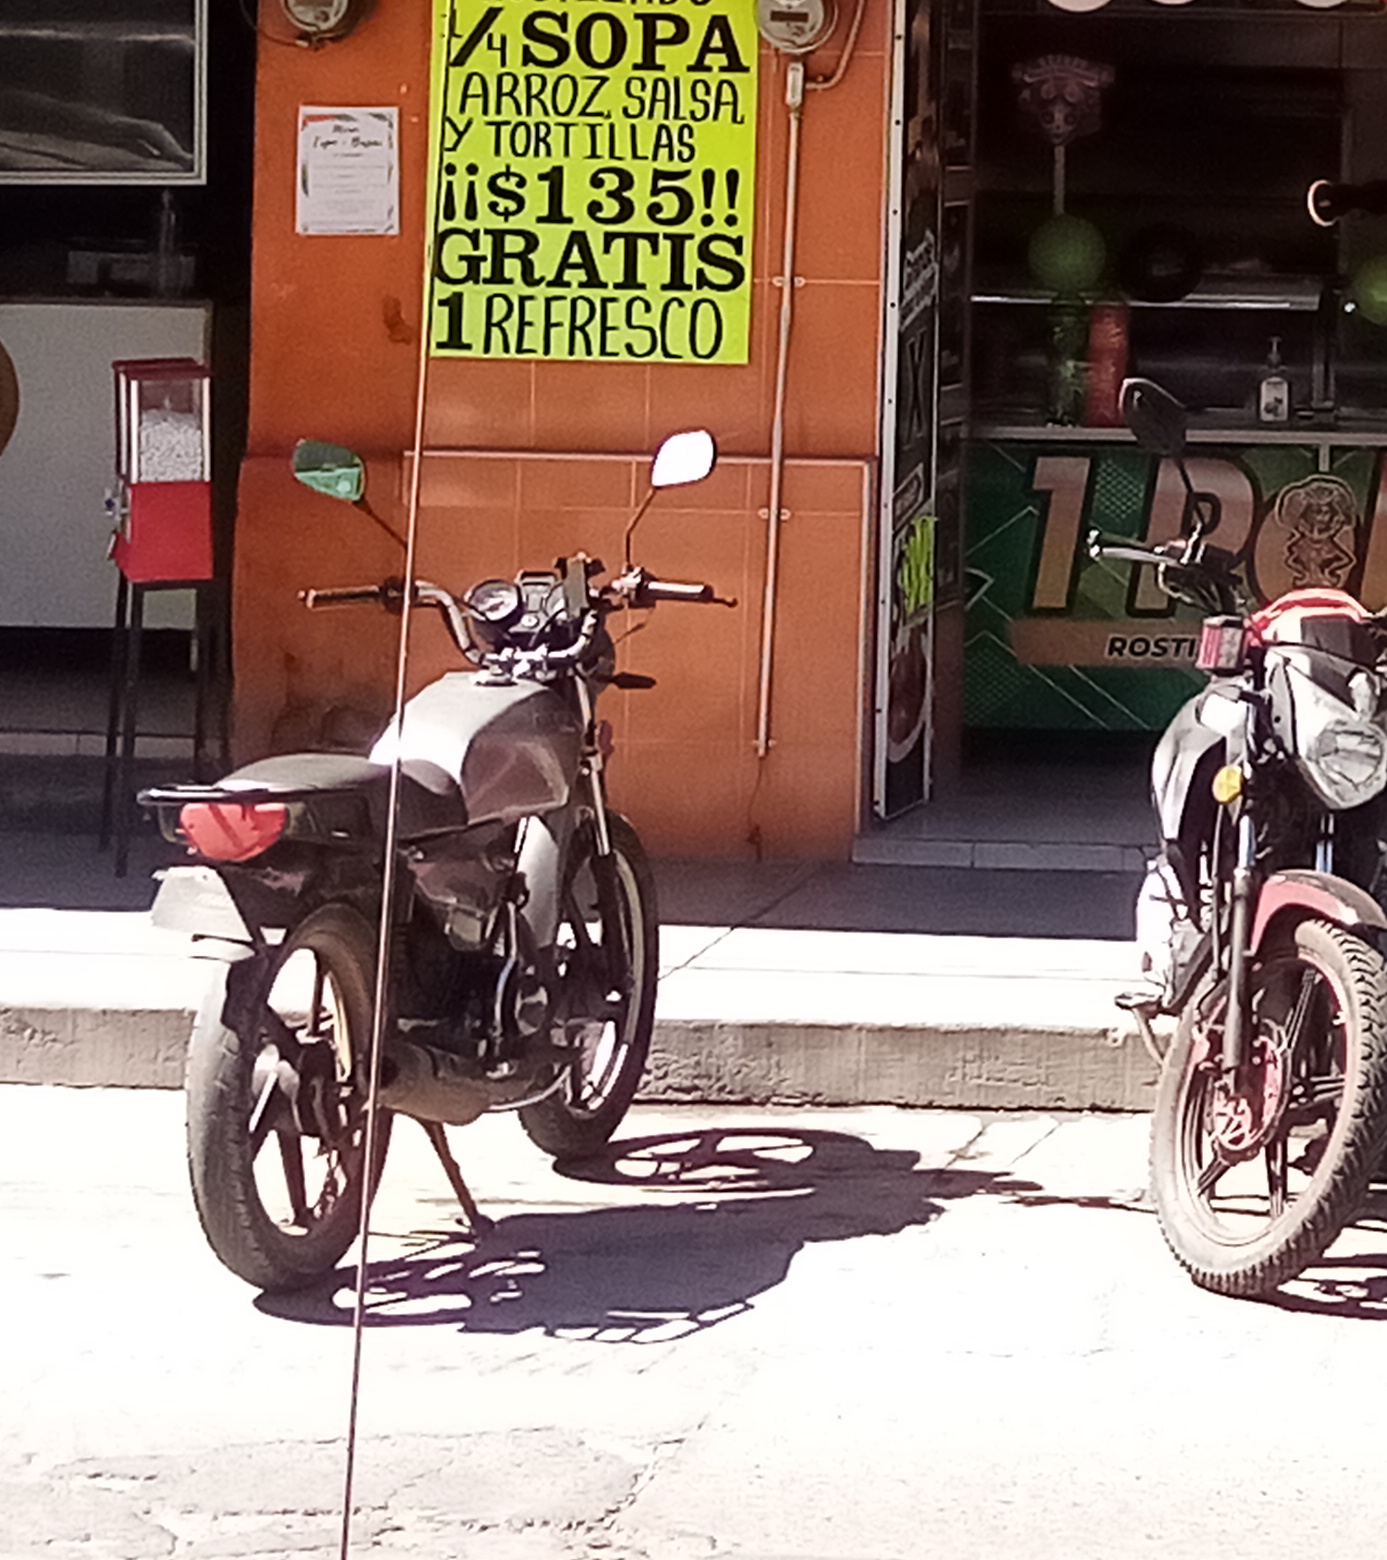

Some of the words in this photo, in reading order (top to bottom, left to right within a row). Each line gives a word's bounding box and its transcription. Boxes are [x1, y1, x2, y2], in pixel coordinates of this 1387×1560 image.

[521, 10, 750, 73] SOPA
[443, 115, 474, 152] Y
[484, 120, 697, 163] TORTILLAS
[433, 228, 746, 291] GRATIS
[435, 291, 473, 351] 1
[484, 292, 724, 360] REFRESCO
